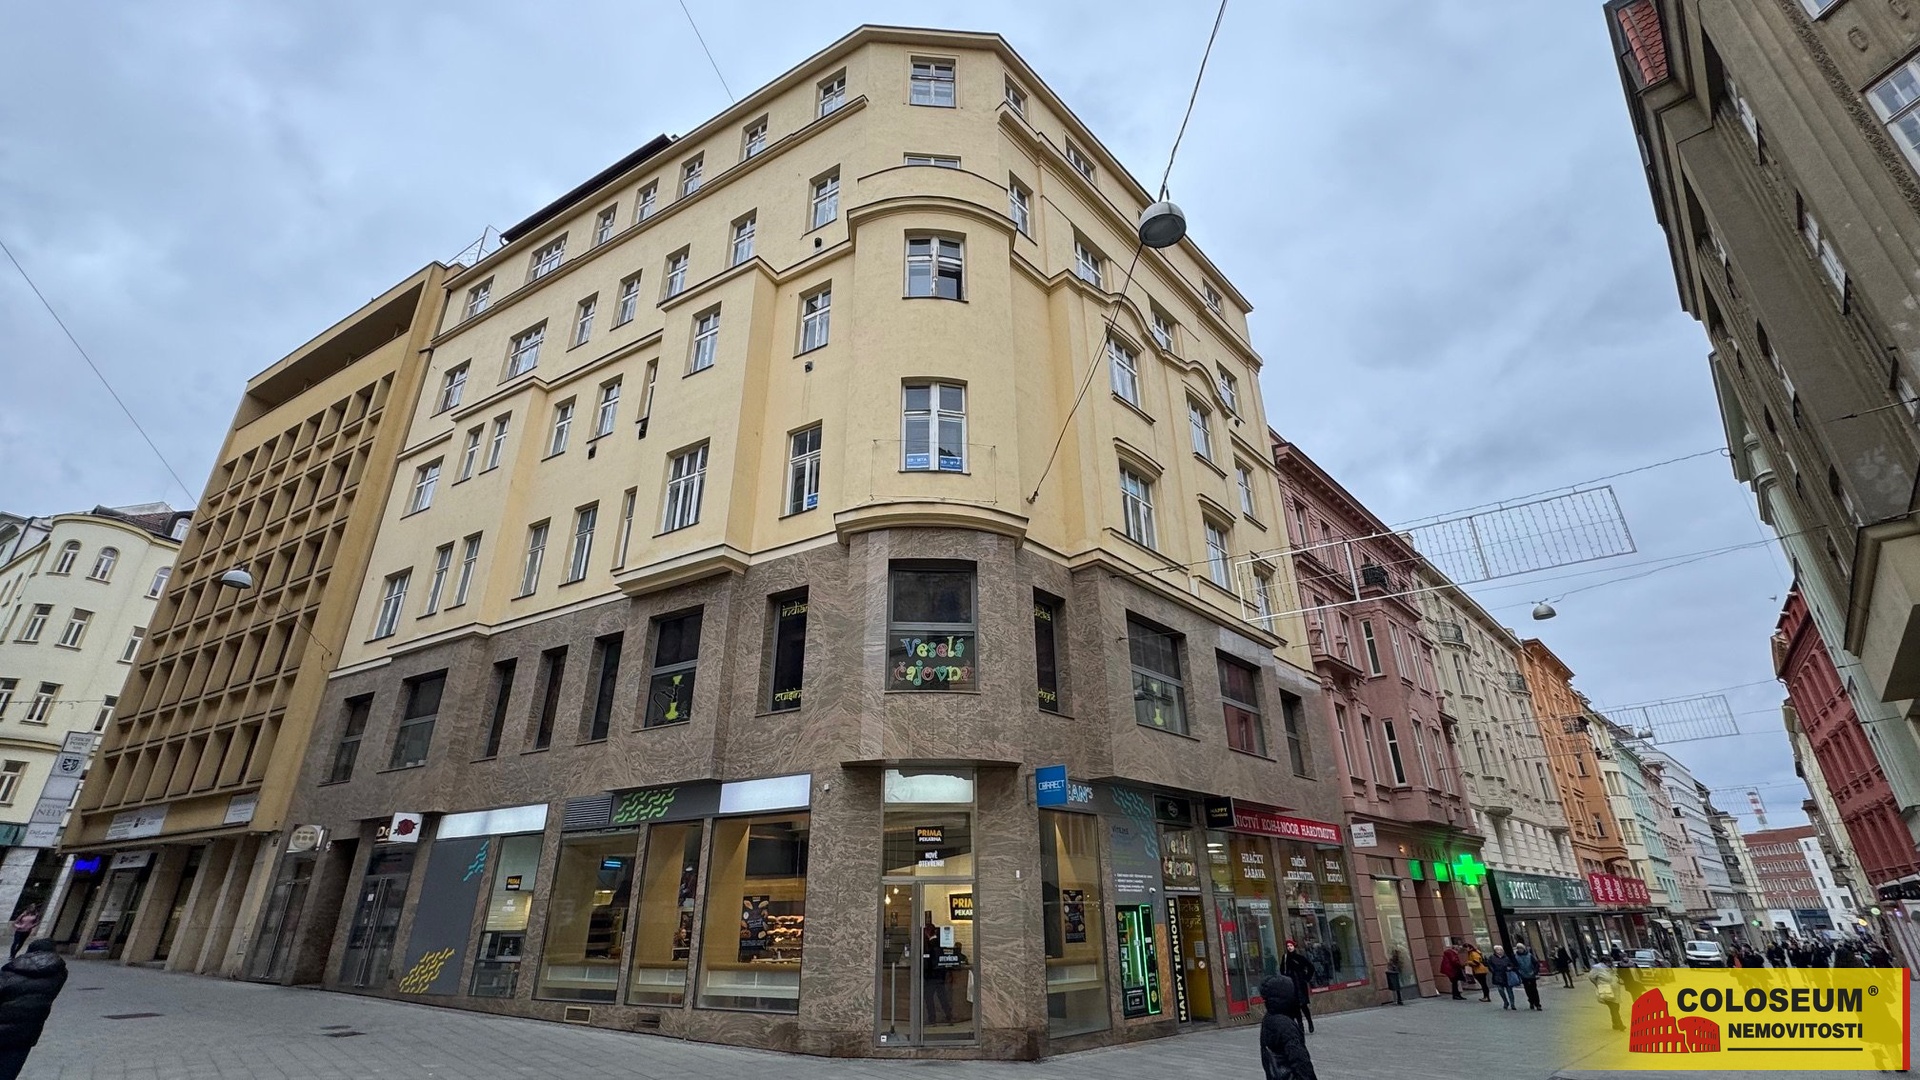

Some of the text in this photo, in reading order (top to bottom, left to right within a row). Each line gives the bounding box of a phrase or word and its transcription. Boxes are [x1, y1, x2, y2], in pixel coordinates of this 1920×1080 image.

[901, 636, 964, 658] Veselá
[1168, 900, 1187, 1020] HAPPY TEAHOUSE
